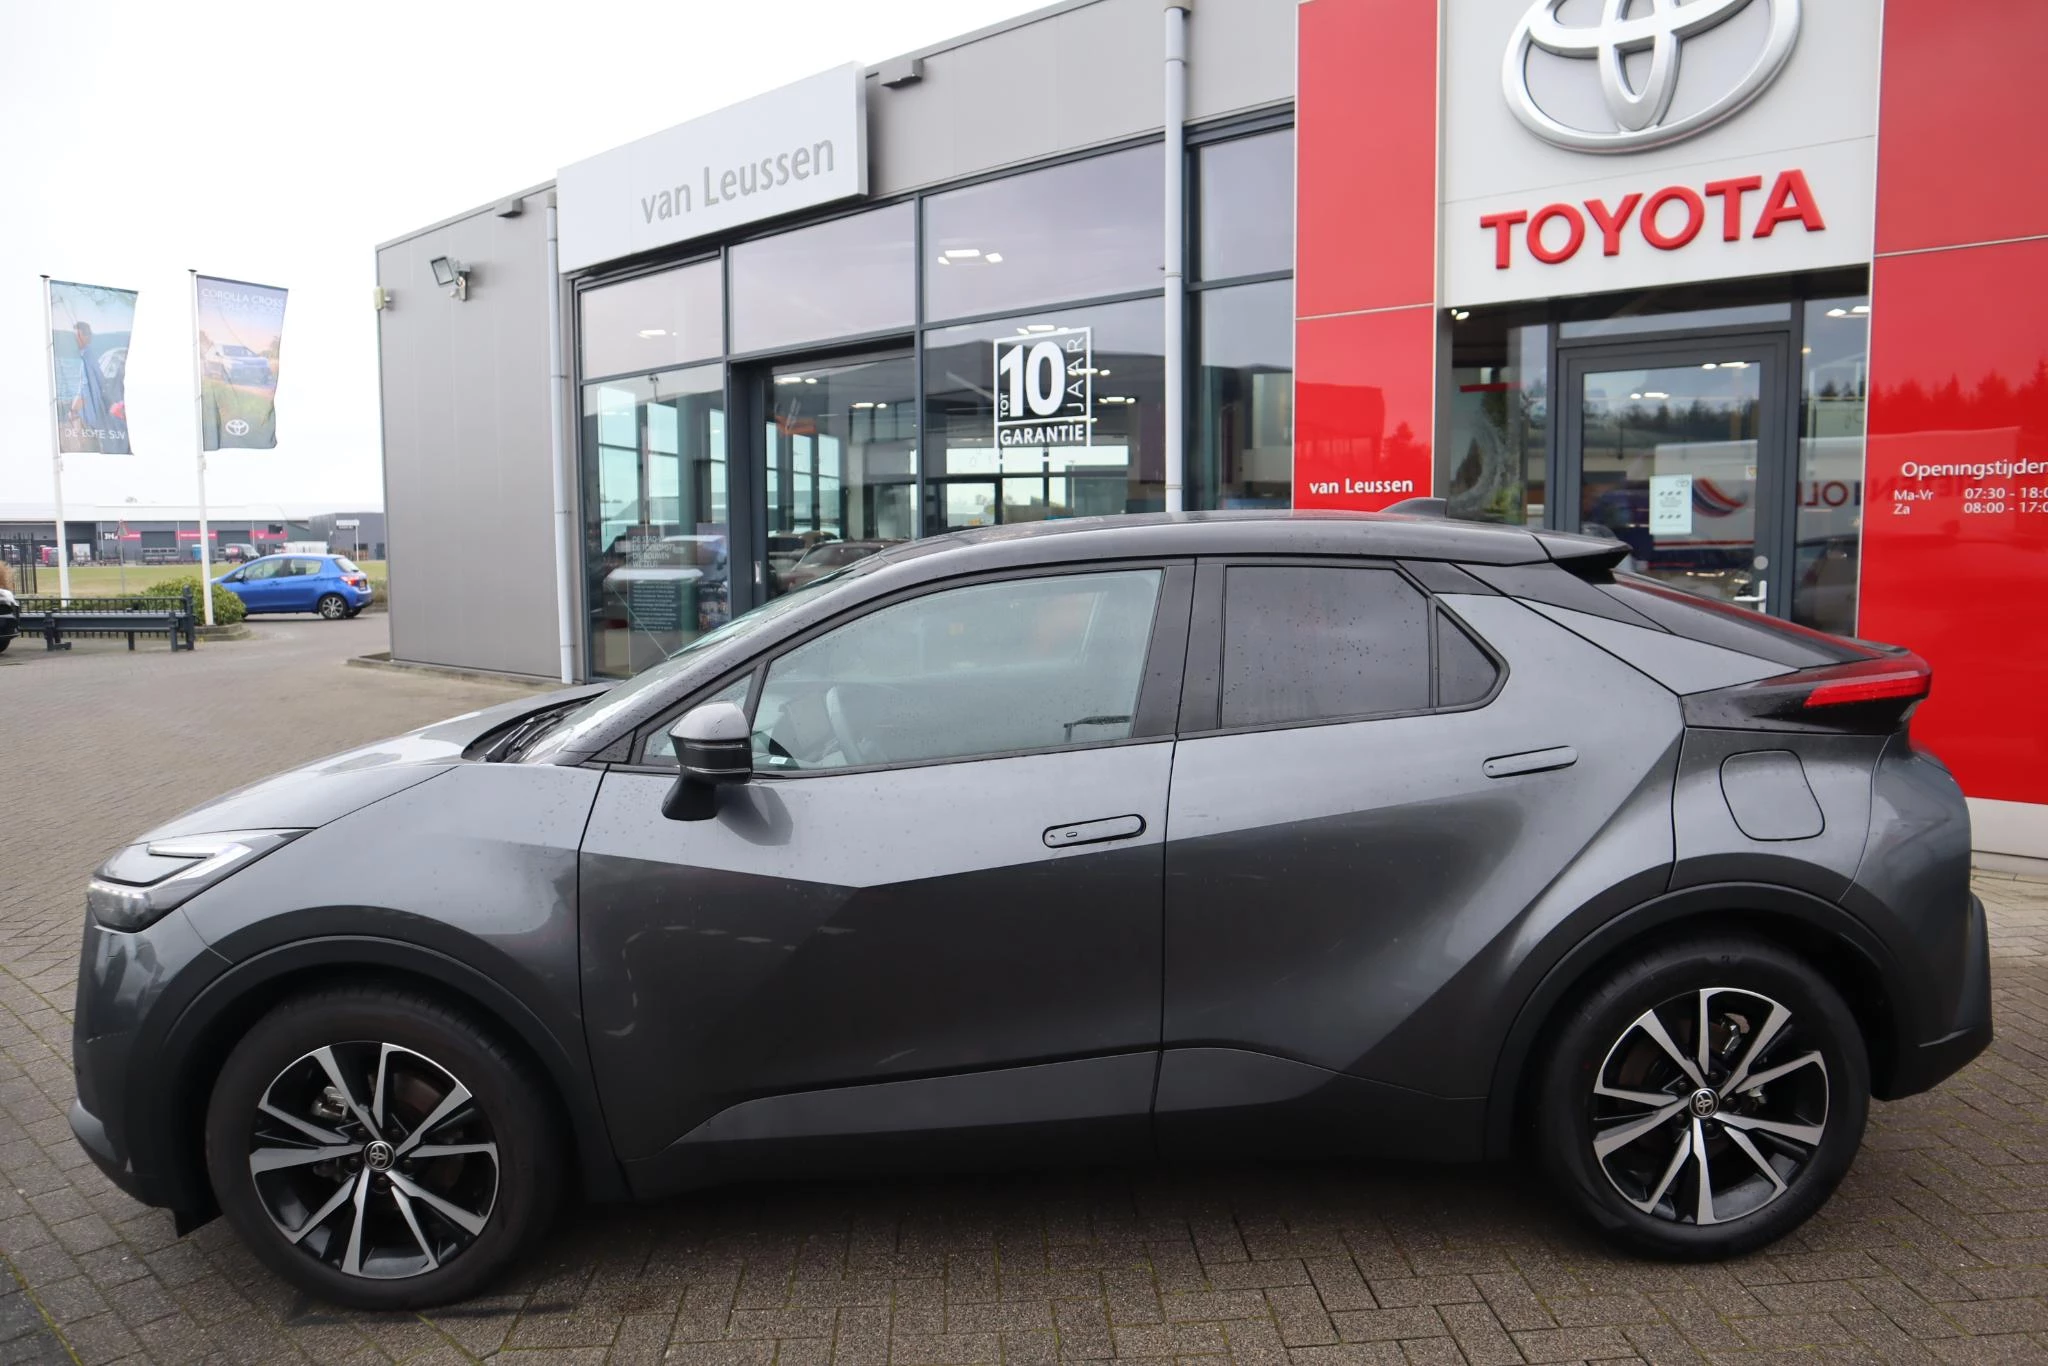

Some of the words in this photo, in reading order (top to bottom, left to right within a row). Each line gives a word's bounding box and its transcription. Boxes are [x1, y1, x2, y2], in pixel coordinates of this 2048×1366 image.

[640, 183, 691, 224] van
[703, 139, 834, 207] Leussen
[1480, 169, 1826, 270] TOYOTA
[1000, 341, 1065, 417] 10
[1067, 336, 1084, 412] JAAR
[1000, 393, 1009, 418] TOT
[108, 429, 126, 440] SUV
[1000, 424, 1084, 445] GARANTIE
[1309, 482, 1339, 494] van
[1345, 478, 1413, 494] Leussen
[1893, 489, 1934, 501] Ma-Vr
[1964, 487, 2005, 499] 07:30
[1893, 503, 1911, 515] Za
[1963, 502, 2005, 513] 08:00
